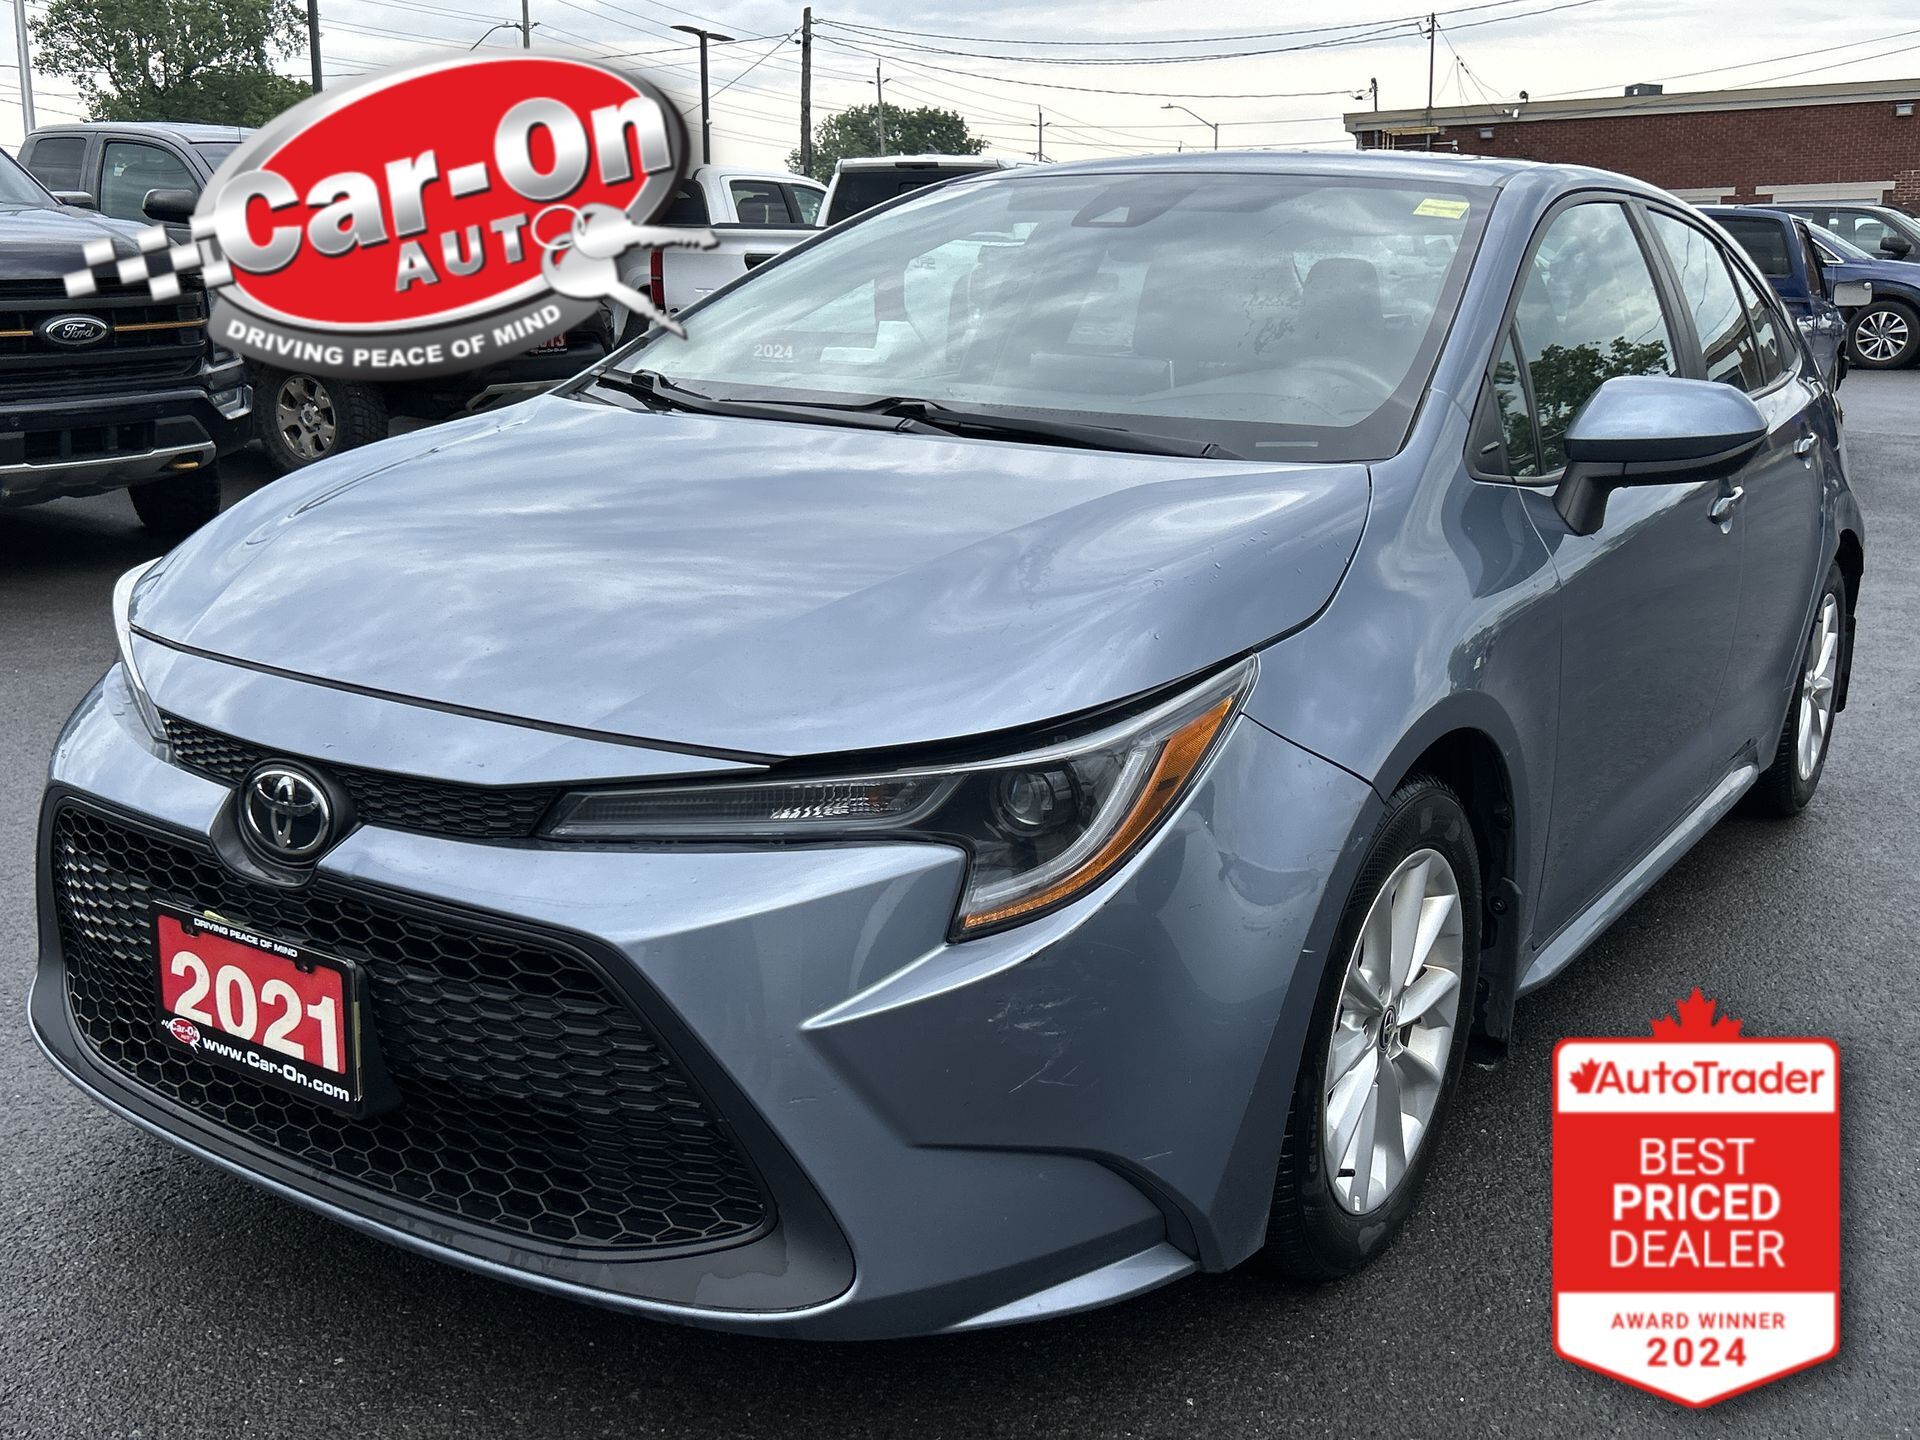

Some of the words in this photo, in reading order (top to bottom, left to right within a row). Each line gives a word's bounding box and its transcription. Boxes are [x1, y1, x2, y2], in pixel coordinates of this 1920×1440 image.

[63, 323, 95, 338] Ford
[753, 344, 793, 359] 2024
[194, 918, 228, 935] DRIVING
[230, 929, 258, 945] PEACE
[260, 939, 272, 949] OF
[273, 943, 298, 957] MIND
[170, 951, 340, 1073] 2021
[202, 1037, 350, 1102] www.Car-On.com
